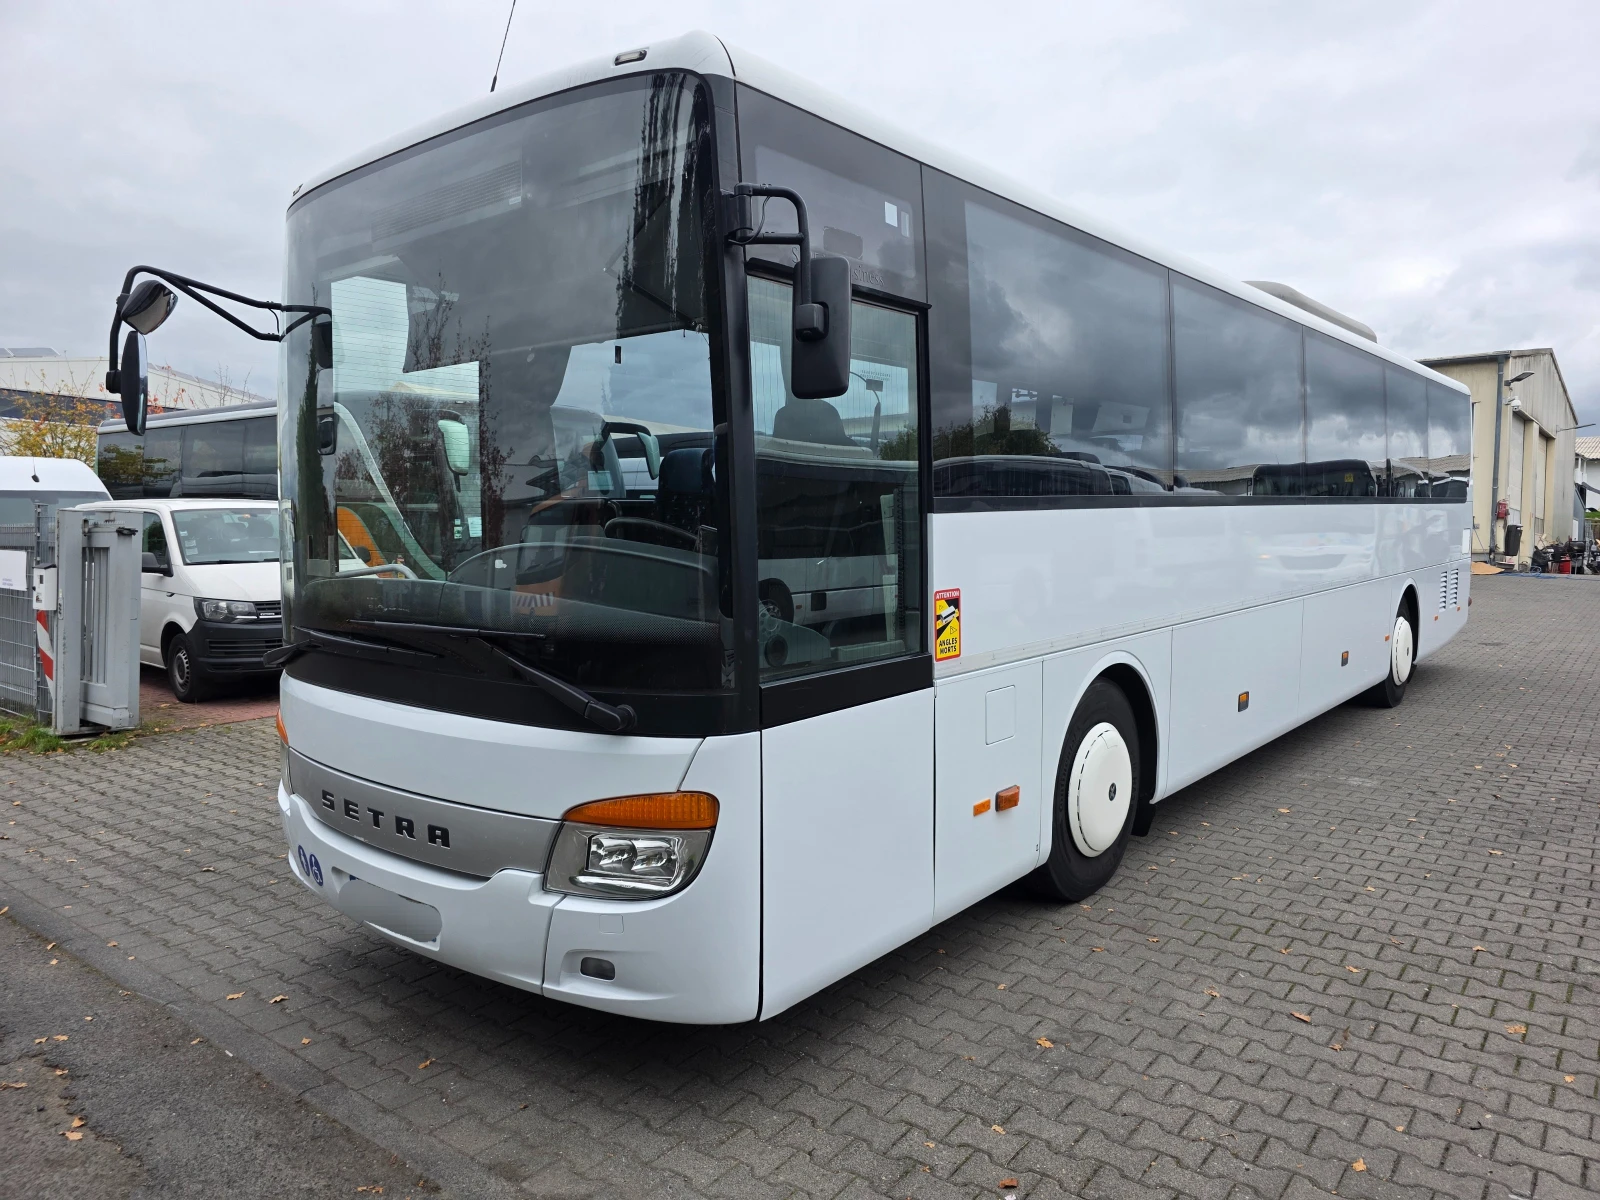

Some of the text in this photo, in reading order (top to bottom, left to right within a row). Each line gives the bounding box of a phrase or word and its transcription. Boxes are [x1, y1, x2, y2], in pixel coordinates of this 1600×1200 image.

[936, 591, 960, 599] ATTENTION
[939, 637, 958, 647] ANGLES
[940, 645, 957, 655] MORTS
[321, 789, 451, 849] SETRA
